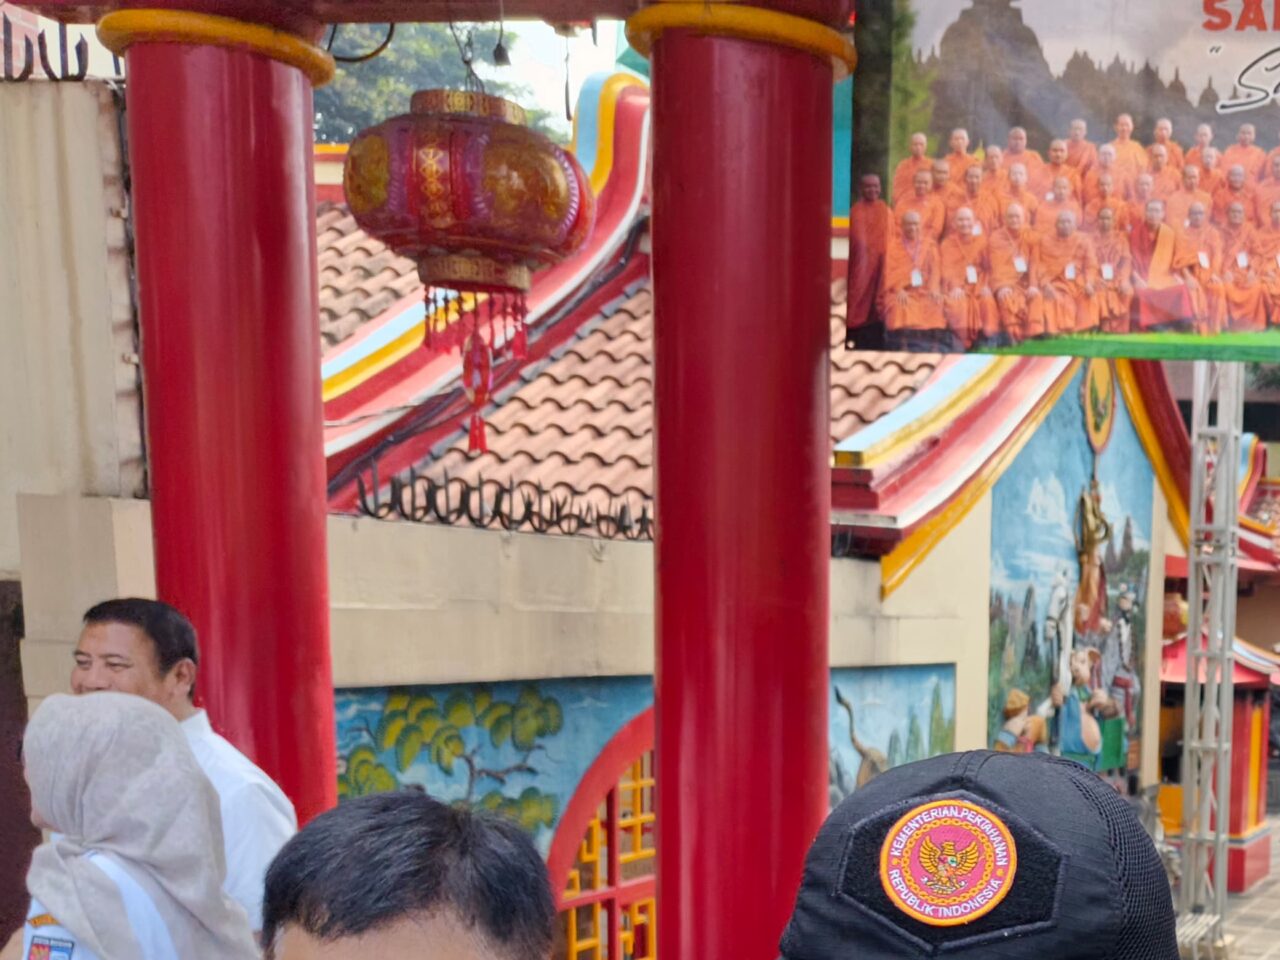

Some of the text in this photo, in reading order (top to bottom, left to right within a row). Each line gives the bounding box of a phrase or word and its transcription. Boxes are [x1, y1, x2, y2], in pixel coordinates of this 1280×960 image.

[890, 806, 957, 856] KEMENTERIAN
[890, 869, 1003, 917] REPUBLIK INDONESIA
